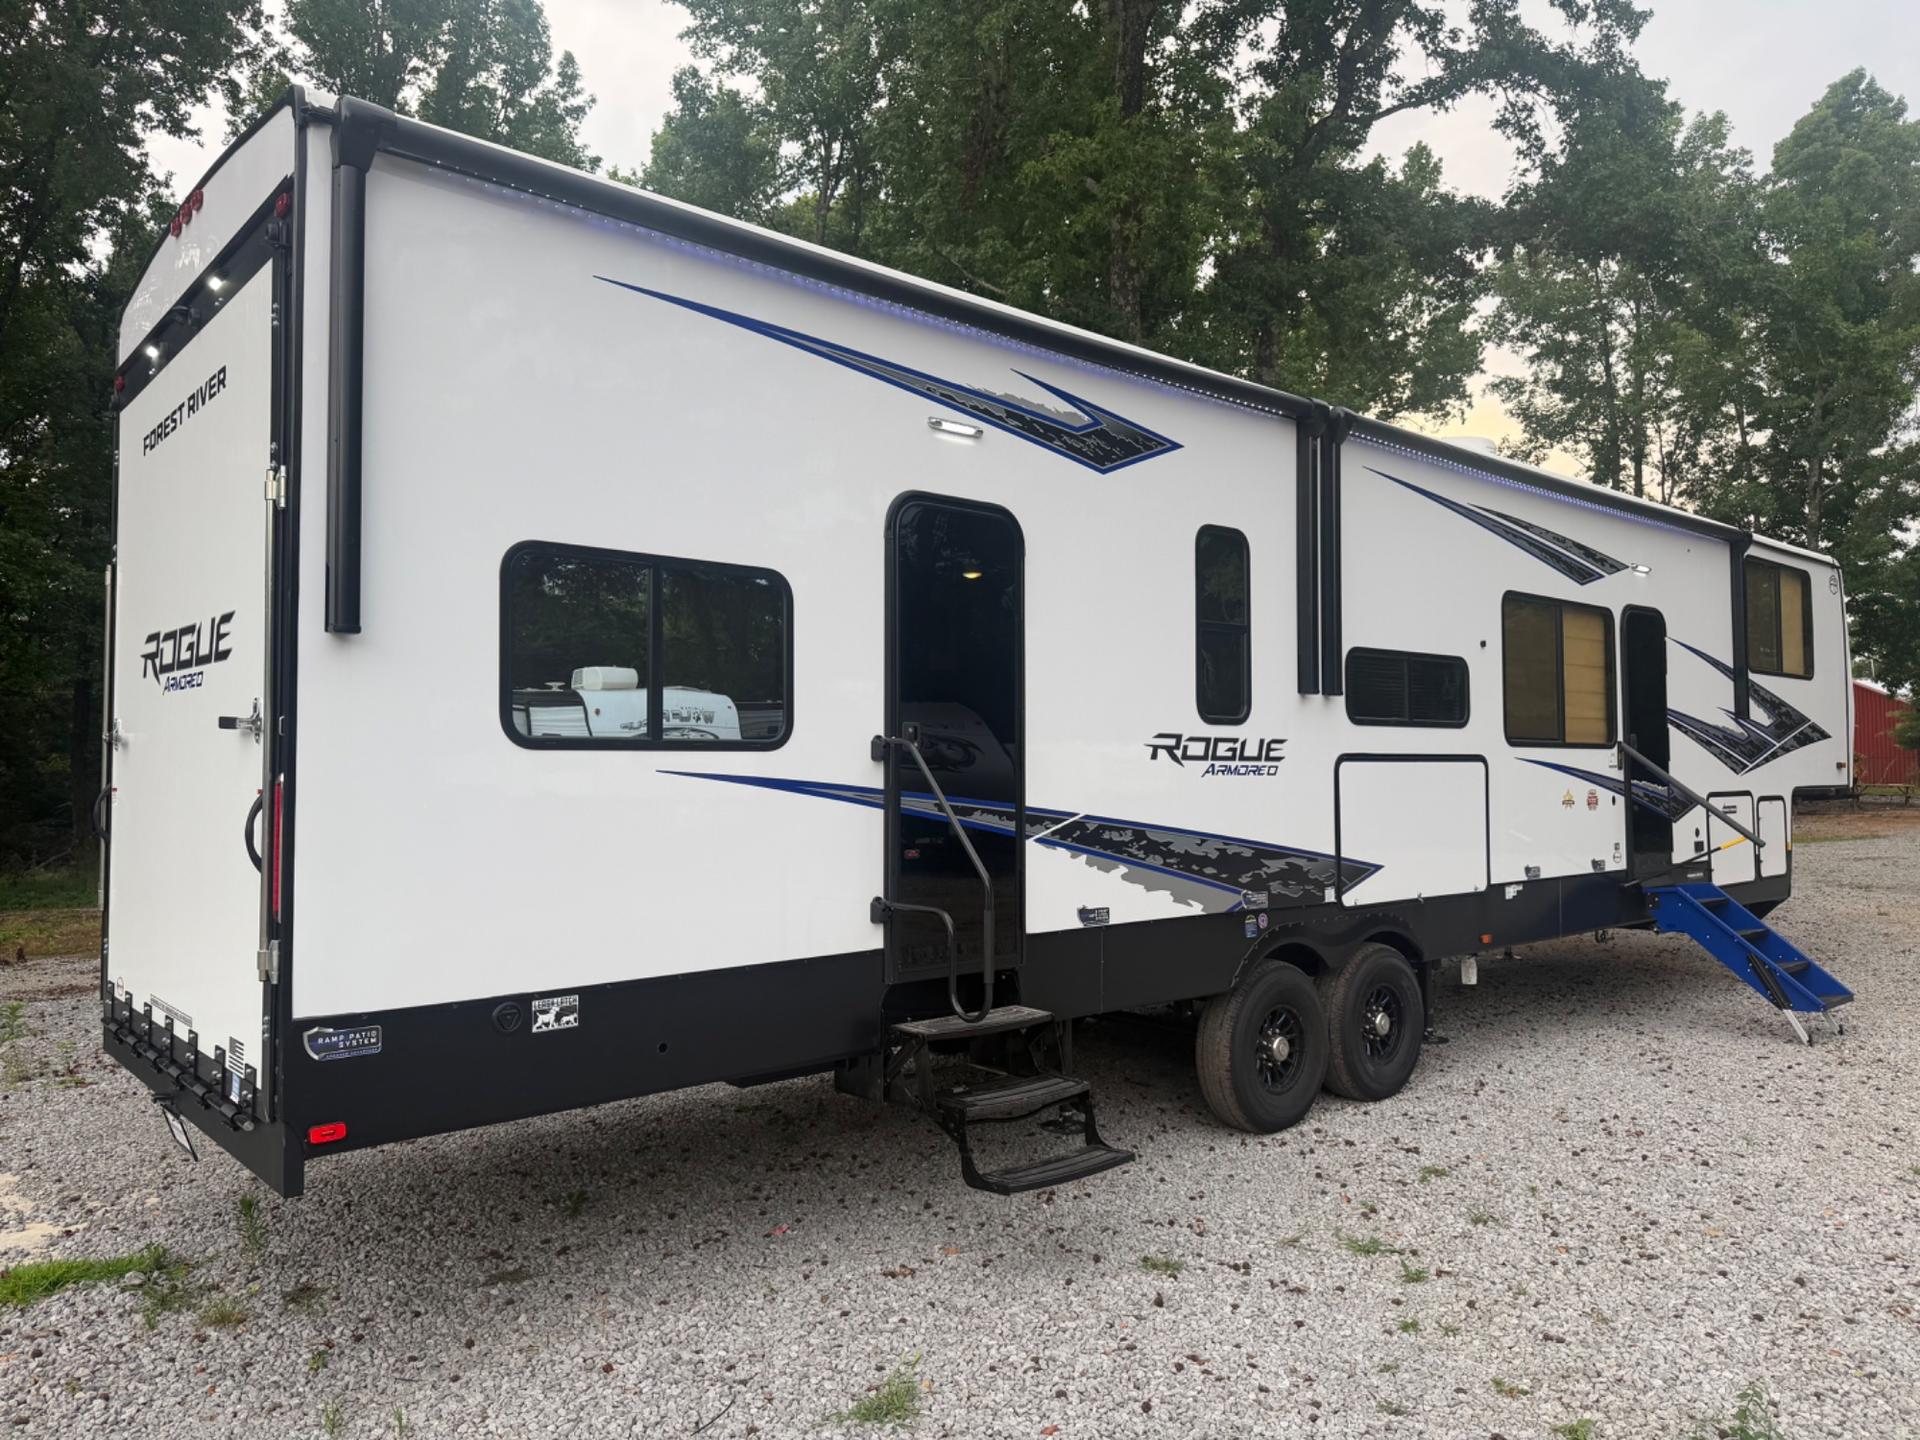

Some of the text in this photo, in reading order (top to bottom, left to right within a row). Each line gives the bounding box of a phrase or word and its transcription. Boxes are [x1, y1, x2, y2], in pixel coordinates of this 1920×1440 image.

[143, 365, 227, 456] FOREST RIVER
[140, 610, 236, 686] ROGUE
[1143, 732, 1289, 768] ROGUE
[317, 1030, 377, 1044] RAMP PATIO
[338, 1037, 377, 1048] SYSTEM
